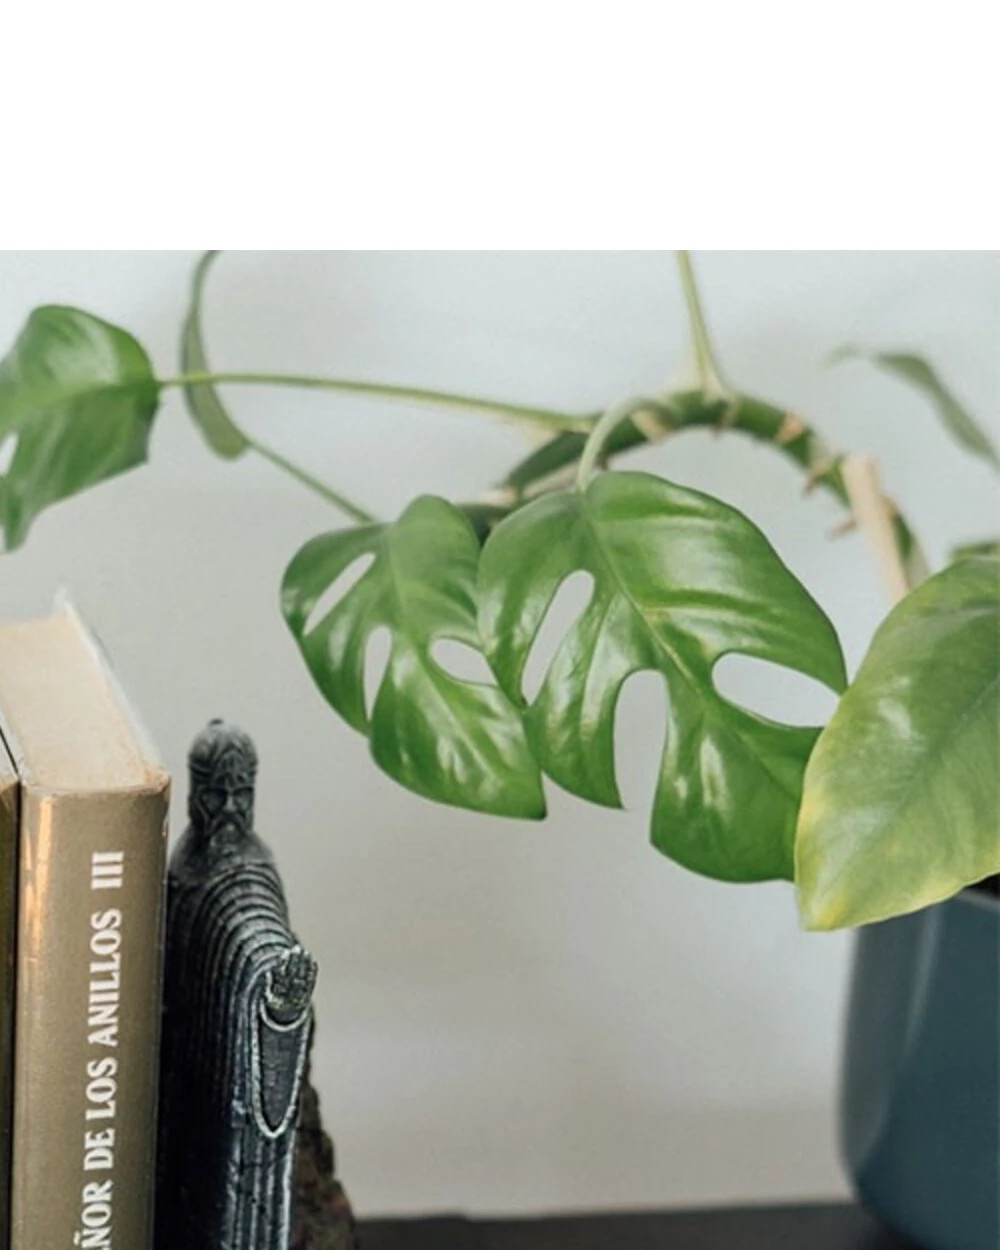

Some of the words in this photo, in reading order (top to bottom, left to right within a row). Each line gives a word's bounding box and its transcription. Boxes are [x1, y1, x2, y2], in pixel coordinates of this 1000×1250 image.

[92, 852, 123, 889] III
[88, 909, 121, 1046] ANILLOS
[86, 1058, 117, 1120] LOS
[84, 1129, 114, 1170] DE
